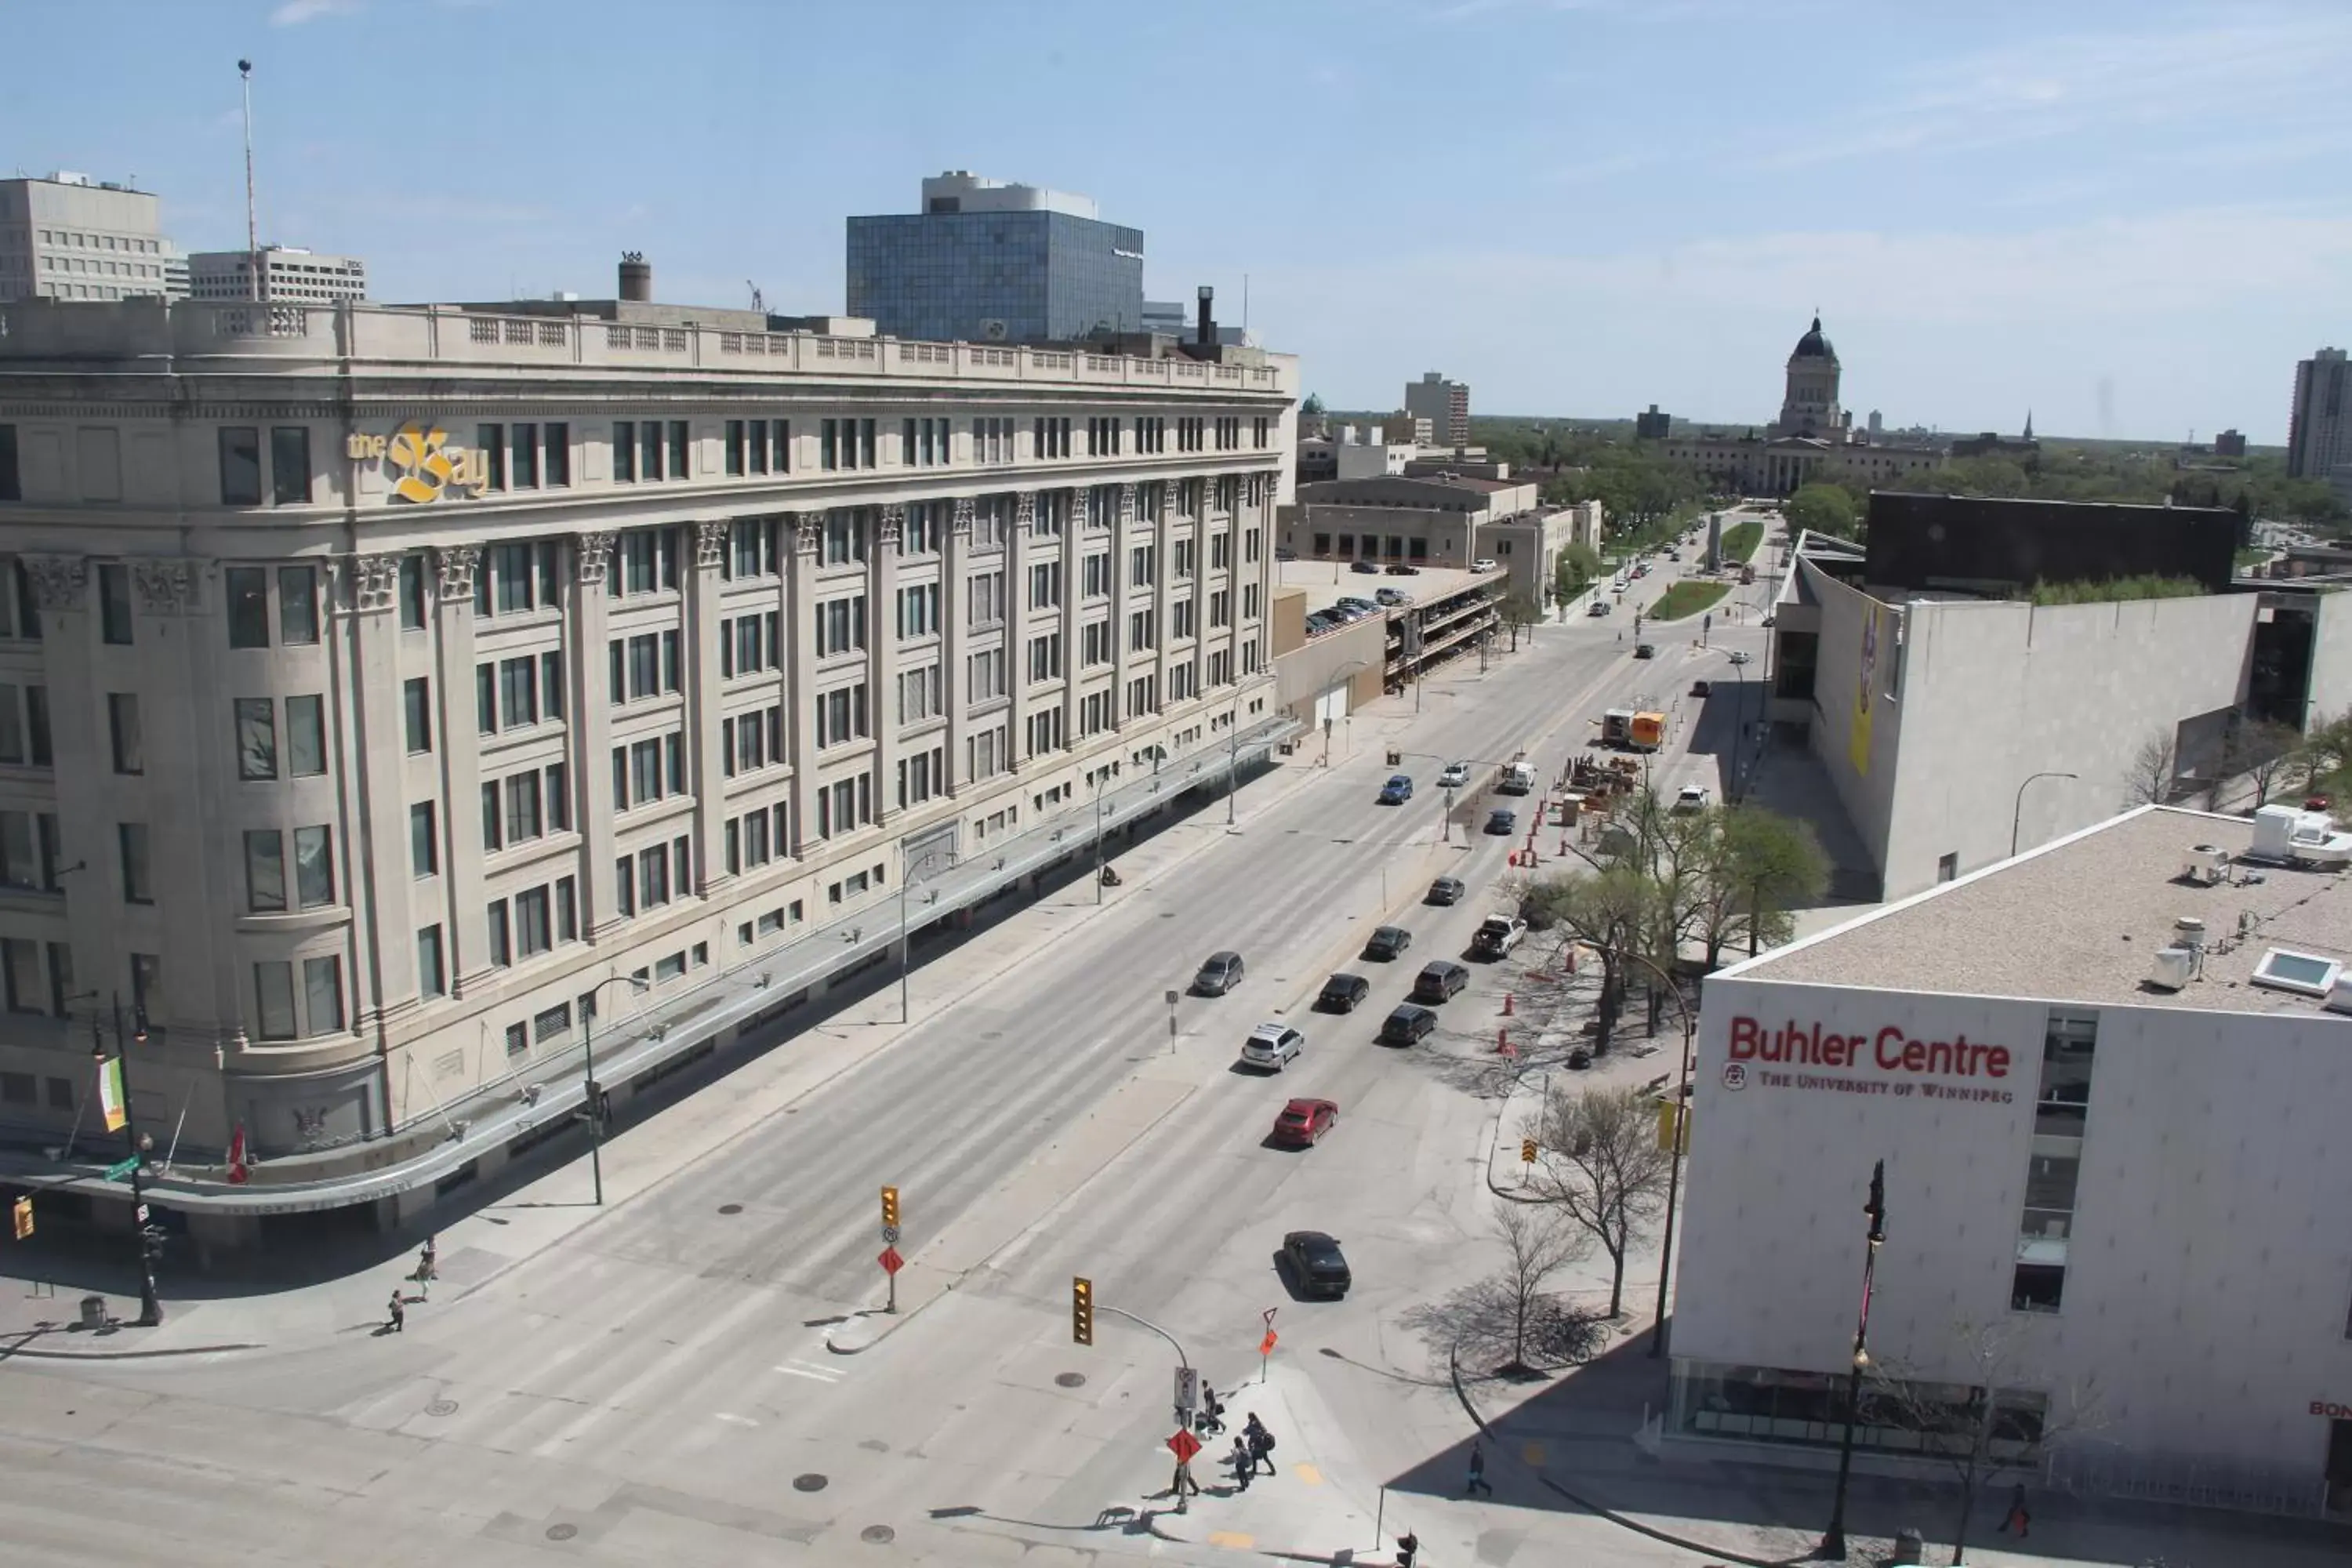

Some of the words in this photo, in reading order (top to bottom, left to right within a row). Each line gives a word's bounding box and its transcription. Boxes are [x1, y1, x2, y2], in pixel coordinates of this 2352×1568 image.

[347, 433, 387, 459] the
[1730, 1016, 1867, 1066] Buhler
[1875, 1025, 2010, 1077] Centre
[1759, 1070, 1792, 1087] THE
[1798, 1074, 1889, 1094] UNIVERSITY
[1894, 1082, 1914, 1097] OF
[1921, 1083, 2013, 1104] WINNIPEG
